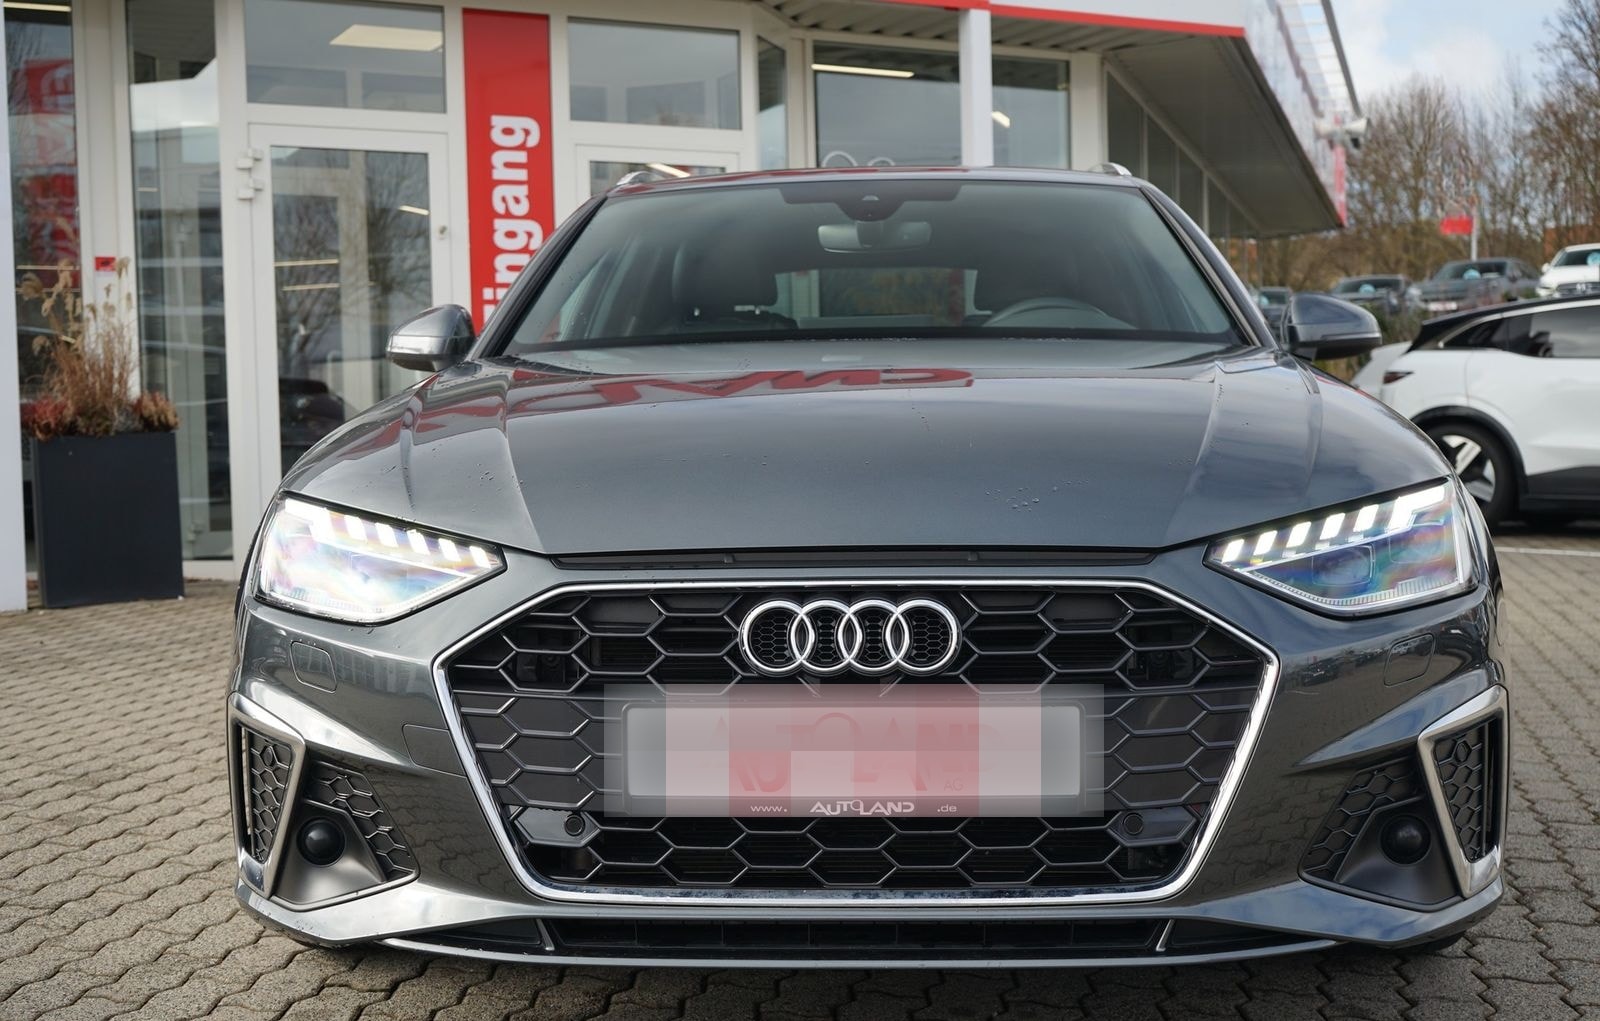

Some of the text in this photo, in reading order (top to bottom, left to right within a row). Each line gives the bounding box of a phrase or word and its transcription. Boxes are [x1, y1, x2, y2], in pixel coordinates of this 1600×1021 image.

[750, 799, 957, 817] www. AUTOLAND .de
